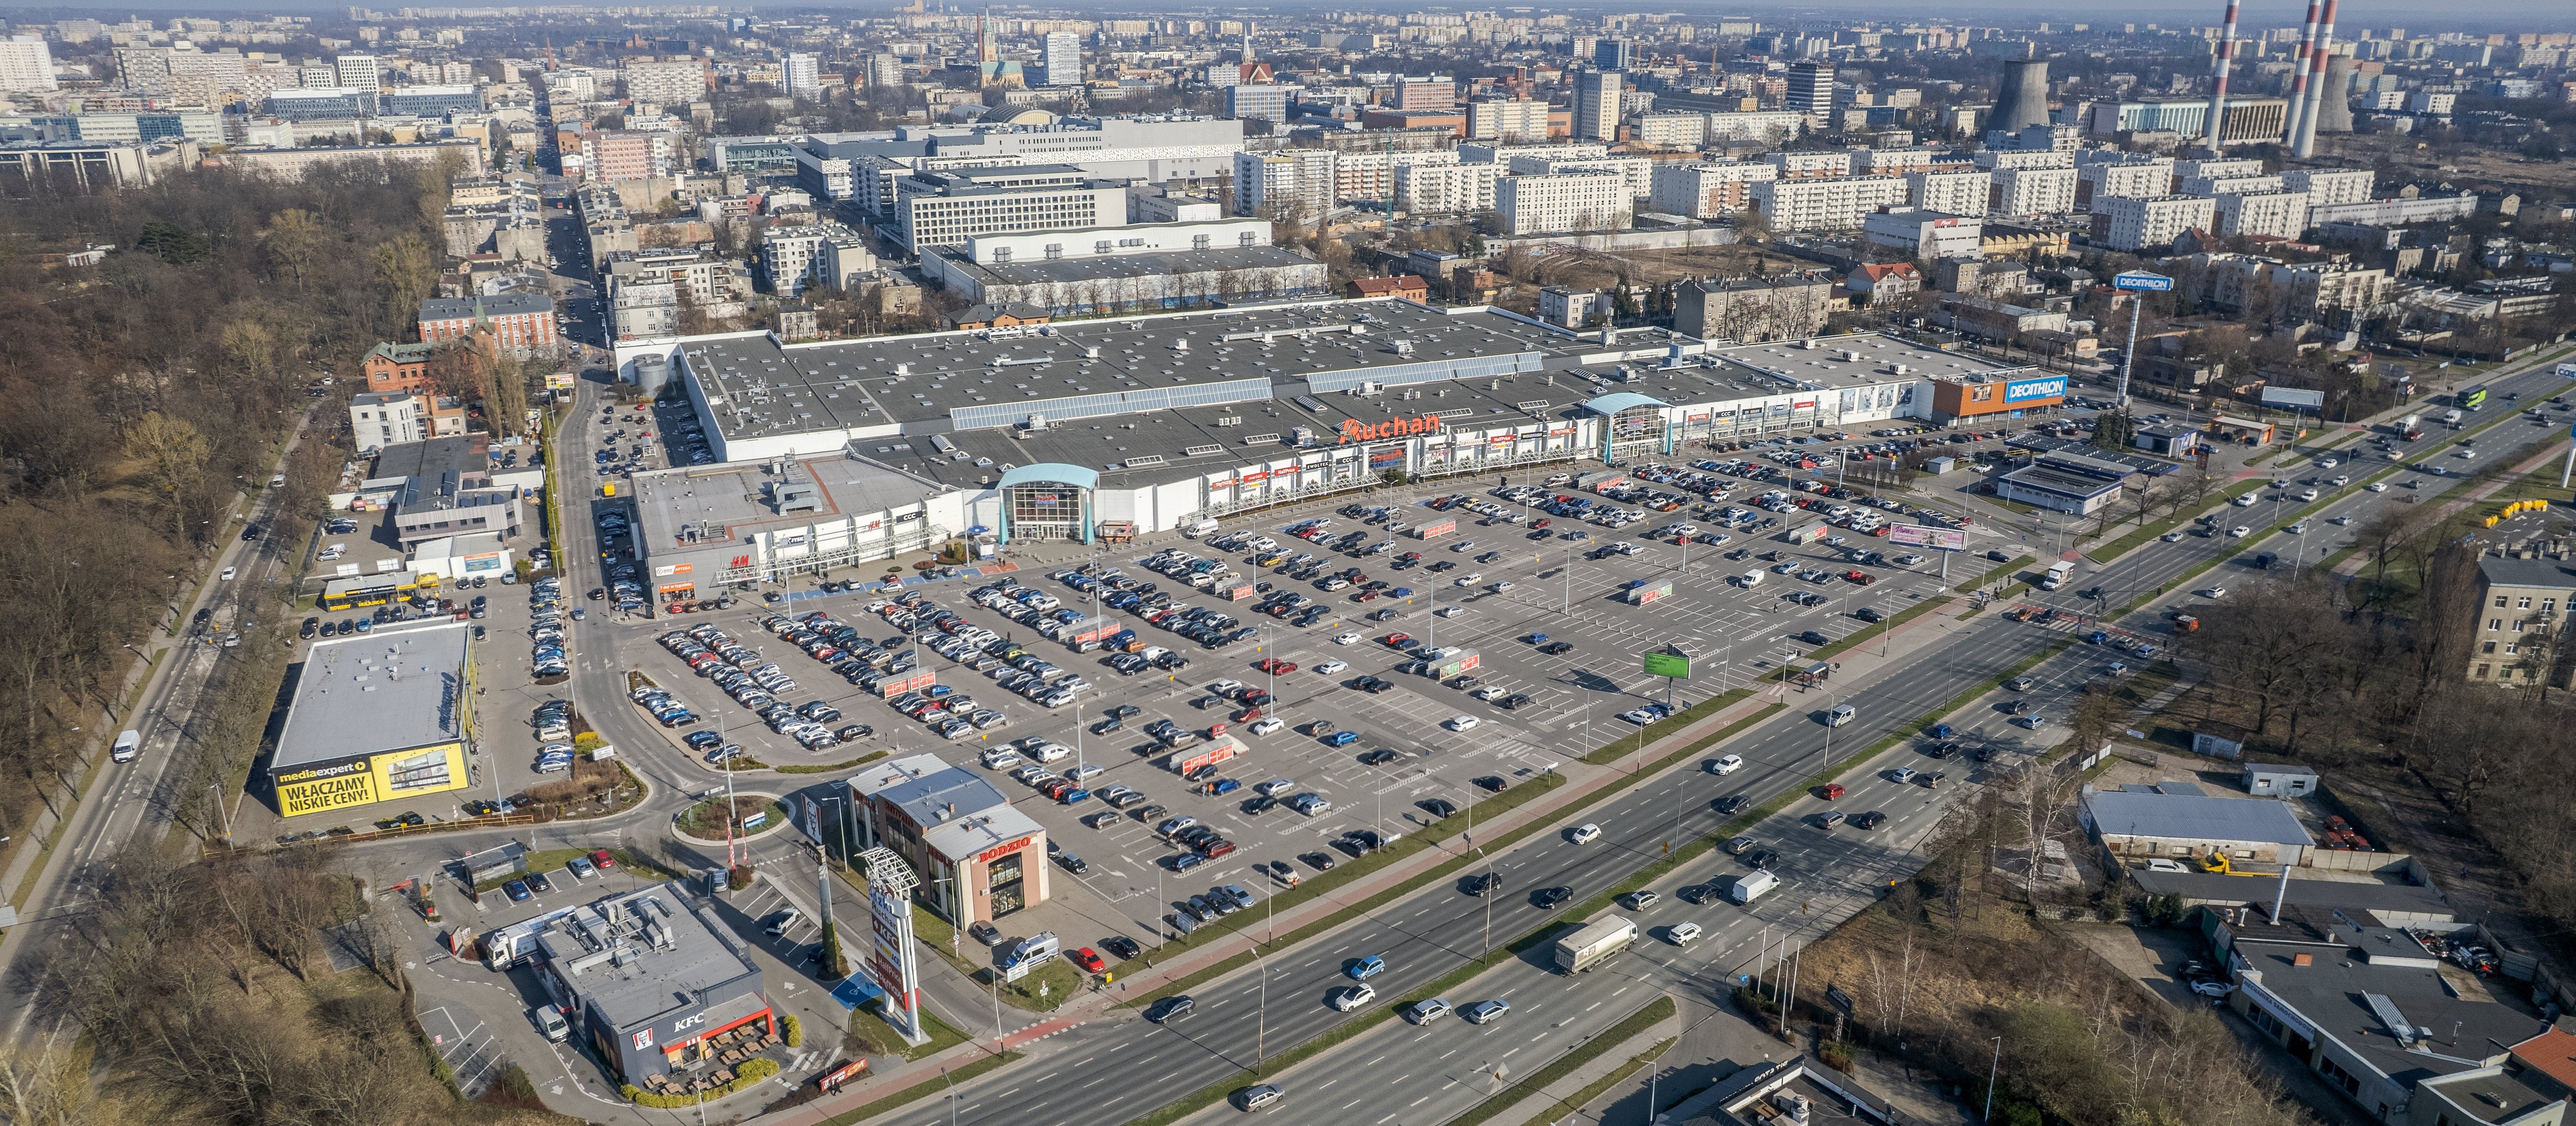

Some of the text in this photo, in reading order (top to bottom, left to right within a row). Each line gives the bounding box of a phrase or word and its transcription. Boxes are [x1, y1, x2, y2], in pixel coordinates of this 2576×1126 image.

[2120, 278, 2167, 288] DECATHLON
[2009, 380, 2064, 398] DECATHLON
[1339, 415, 1440, 444] Auchan
[730, 555, 750, 567] H&M
[279, 763, 355, 783] mediaexpert
[289, 789, 369, 812] NISKIE CENY!
[806, 845, 818, 863] KFC
[979, 837, 1031, 863] BODZIO
[880, 924, 897, 948] KFC
[878, 956, 902, 984] HalfPrice
[788, 989, 809, 999] WYJAZD
[2244, 980, 2313, 1034] MECHANIKA SAMOCHODOWA
[674, 1012, 704, 1033] KFC
